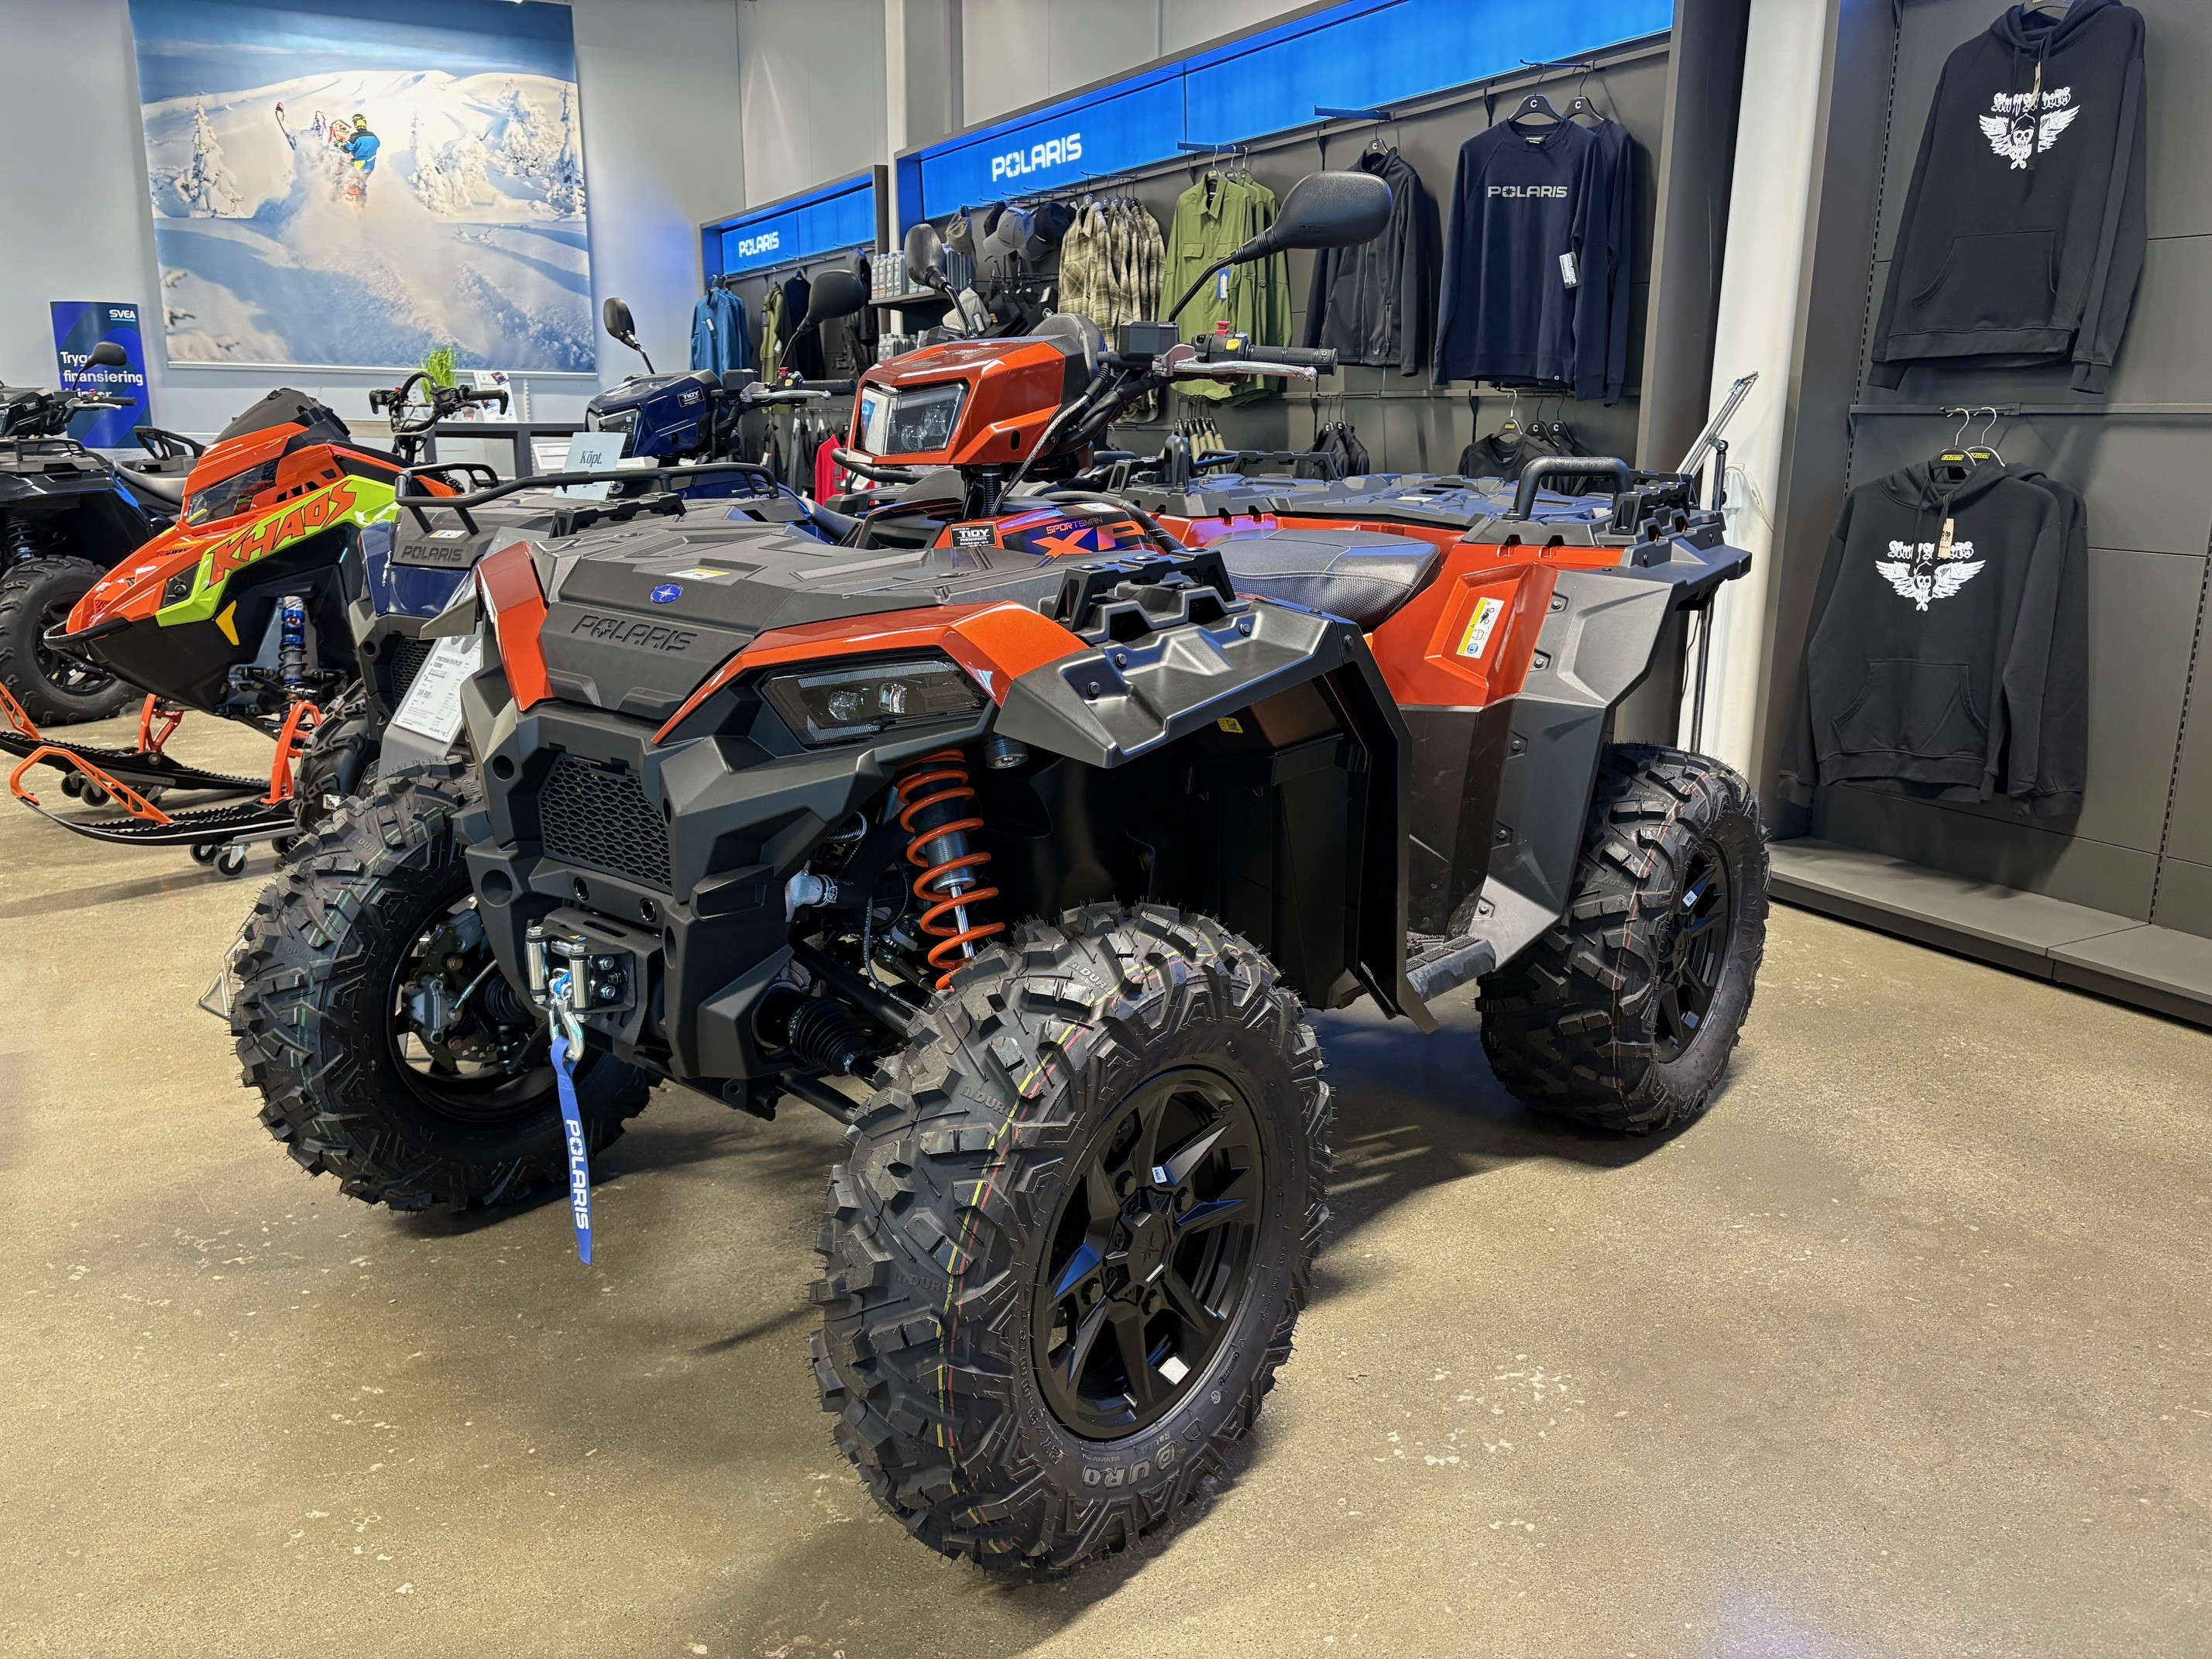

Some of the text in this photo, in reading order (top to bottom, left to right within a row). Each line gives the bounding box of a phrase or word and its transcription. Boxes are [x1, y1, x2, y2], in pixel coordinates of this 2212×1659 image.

[1530, 99, 1538, 108] C
[1575, 101, 1582, 109] C
[992, 132, 1082, 182] POLARIS
[1487, 185, 1568, 198] POLARIS
[738, 231, 780, 258] POLARIS
[109, 309, 136, 319] SVEA
[63, 370, 144, 386] finansiering
[959, 528, 990, 538] TIDY
[1046, 517, 1104, 535] SPORTSMAN
[203, 480, 357, 592] KHAOS
[1032, 520, 1145, 559] XP
[400, 545, 464, 562] POLARIS
[571, 614, 698, 651] POLARIS
[566, 1119, 589, 1230] POLARIS
[1082, 1440, 1178, 1489] DURO
